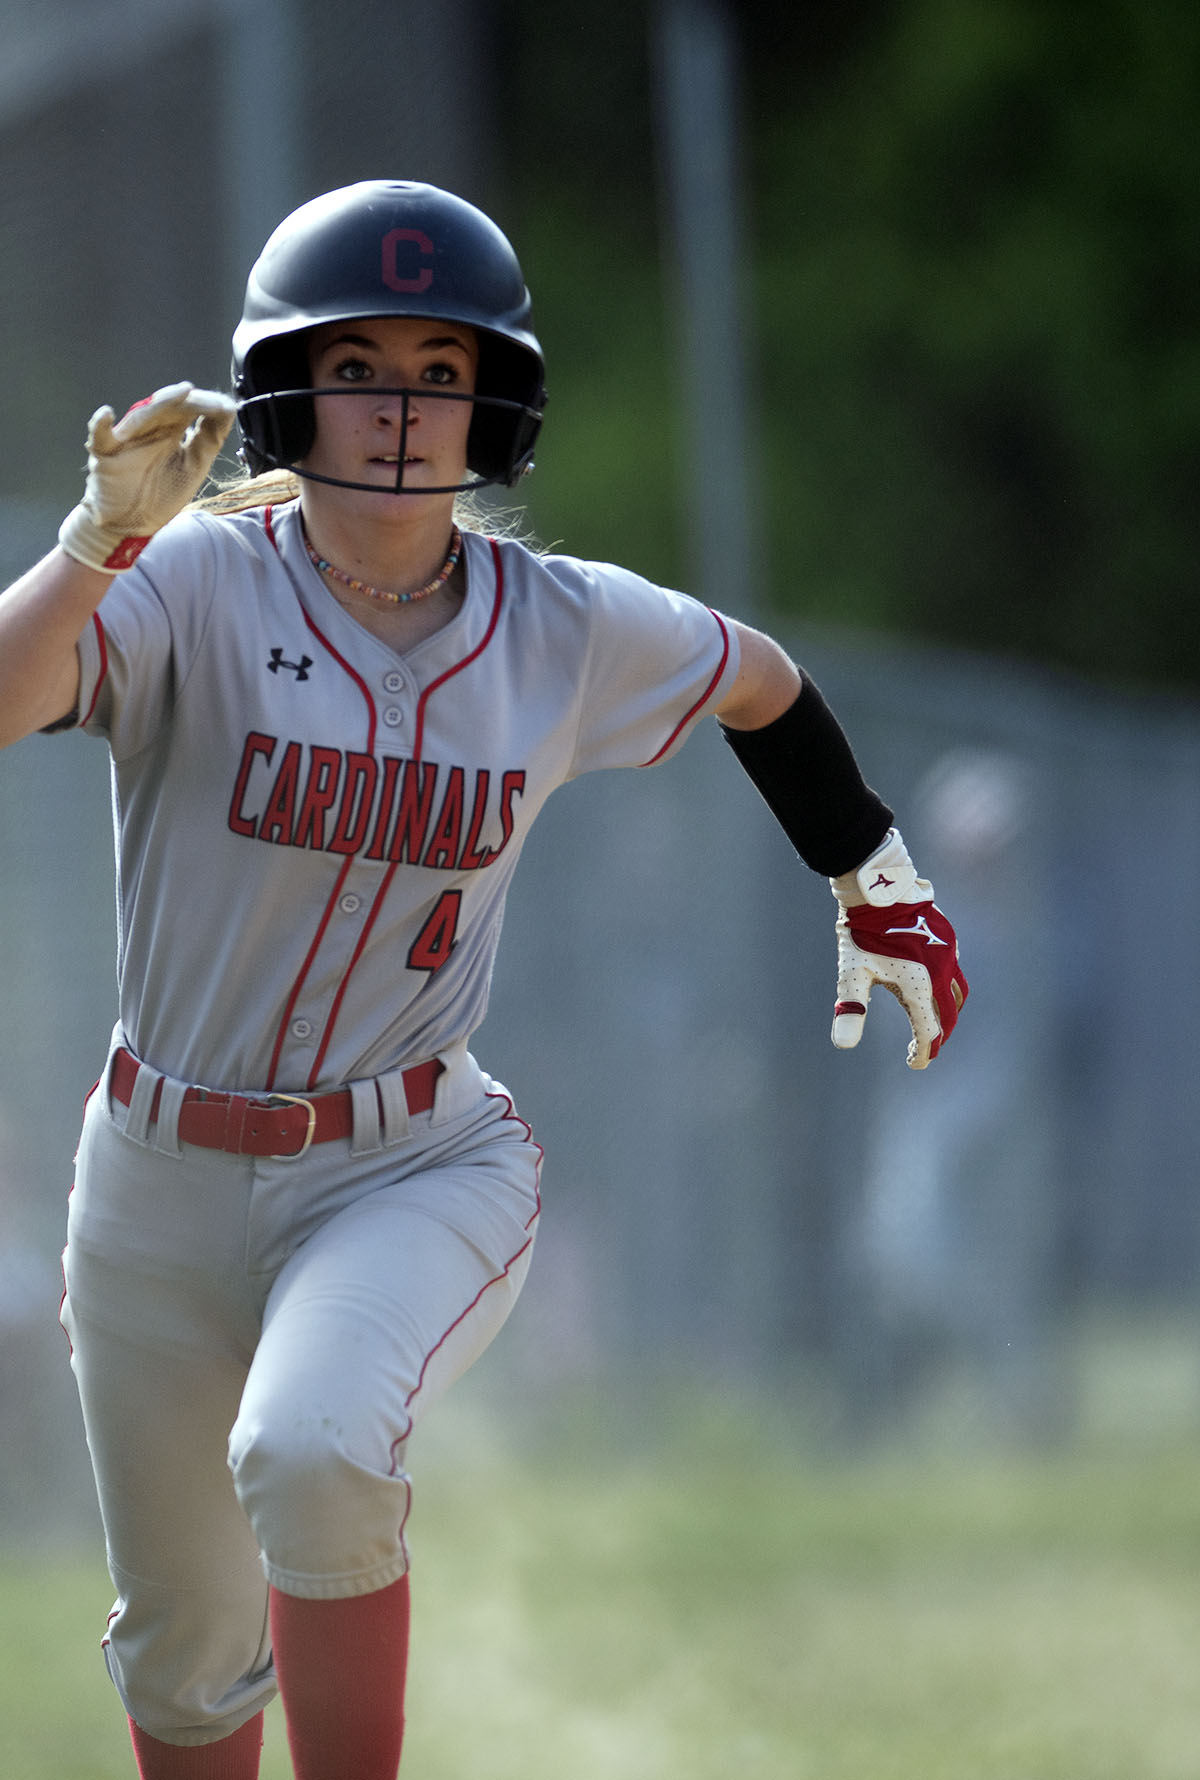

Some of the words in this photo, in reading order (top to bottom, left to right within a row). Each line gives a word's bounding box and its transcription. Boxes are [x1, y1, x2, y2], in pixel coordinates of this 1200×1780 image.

[381, 228, 433, 294] C
[228, 731, 526, 870] CARDINALS
[405, 889, 462, 976] 4
